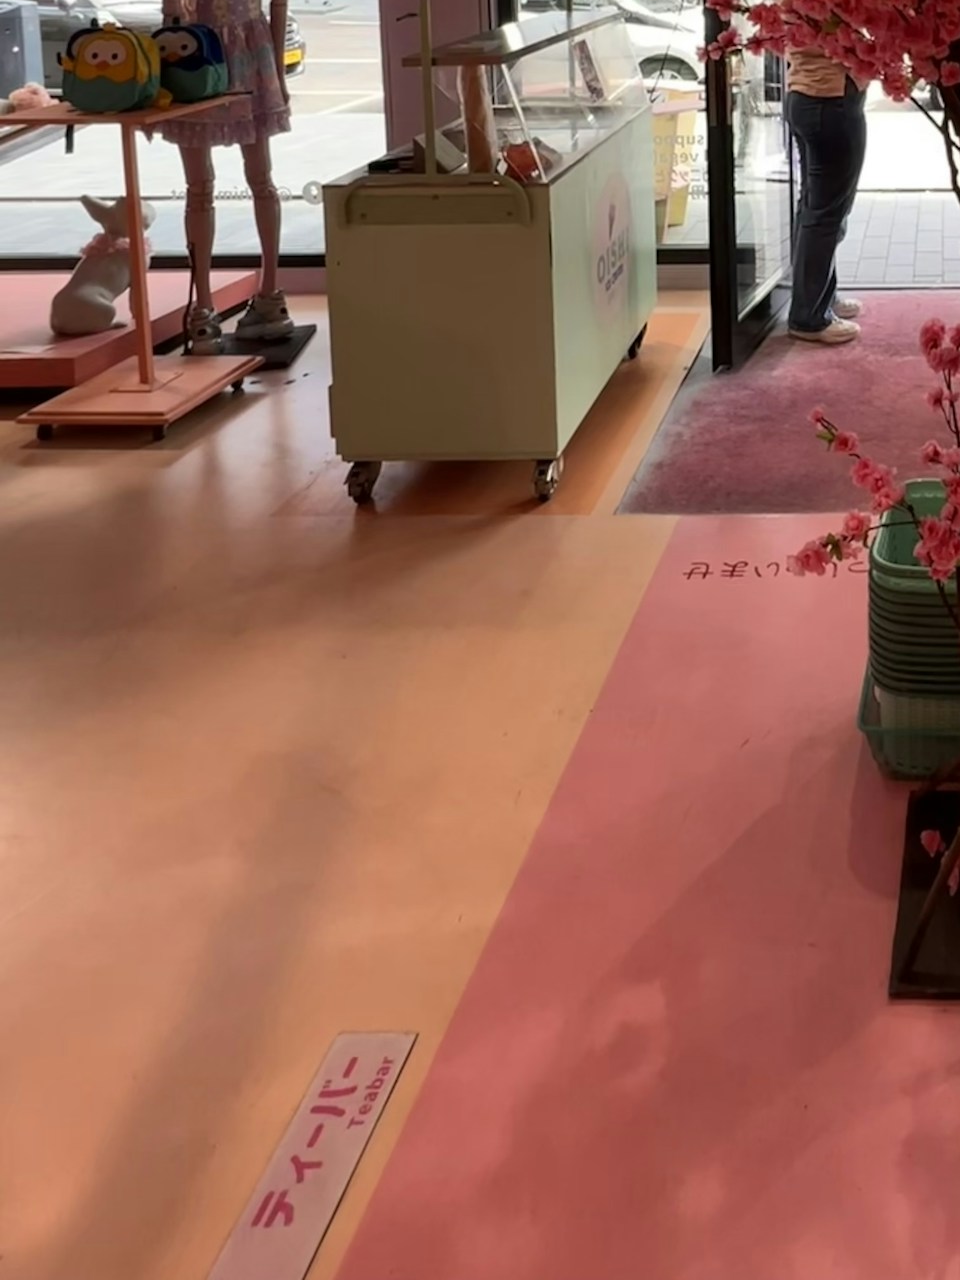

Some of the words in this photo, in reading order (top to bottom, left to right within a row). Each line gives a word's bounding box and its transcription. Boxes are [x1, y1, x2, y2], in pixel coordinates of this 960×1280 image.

[682, 560, 869, 580] っしいませ
[346, 1056, 395, 1130] Teabar
[251, 1056, 359, 1228] ティーバー
